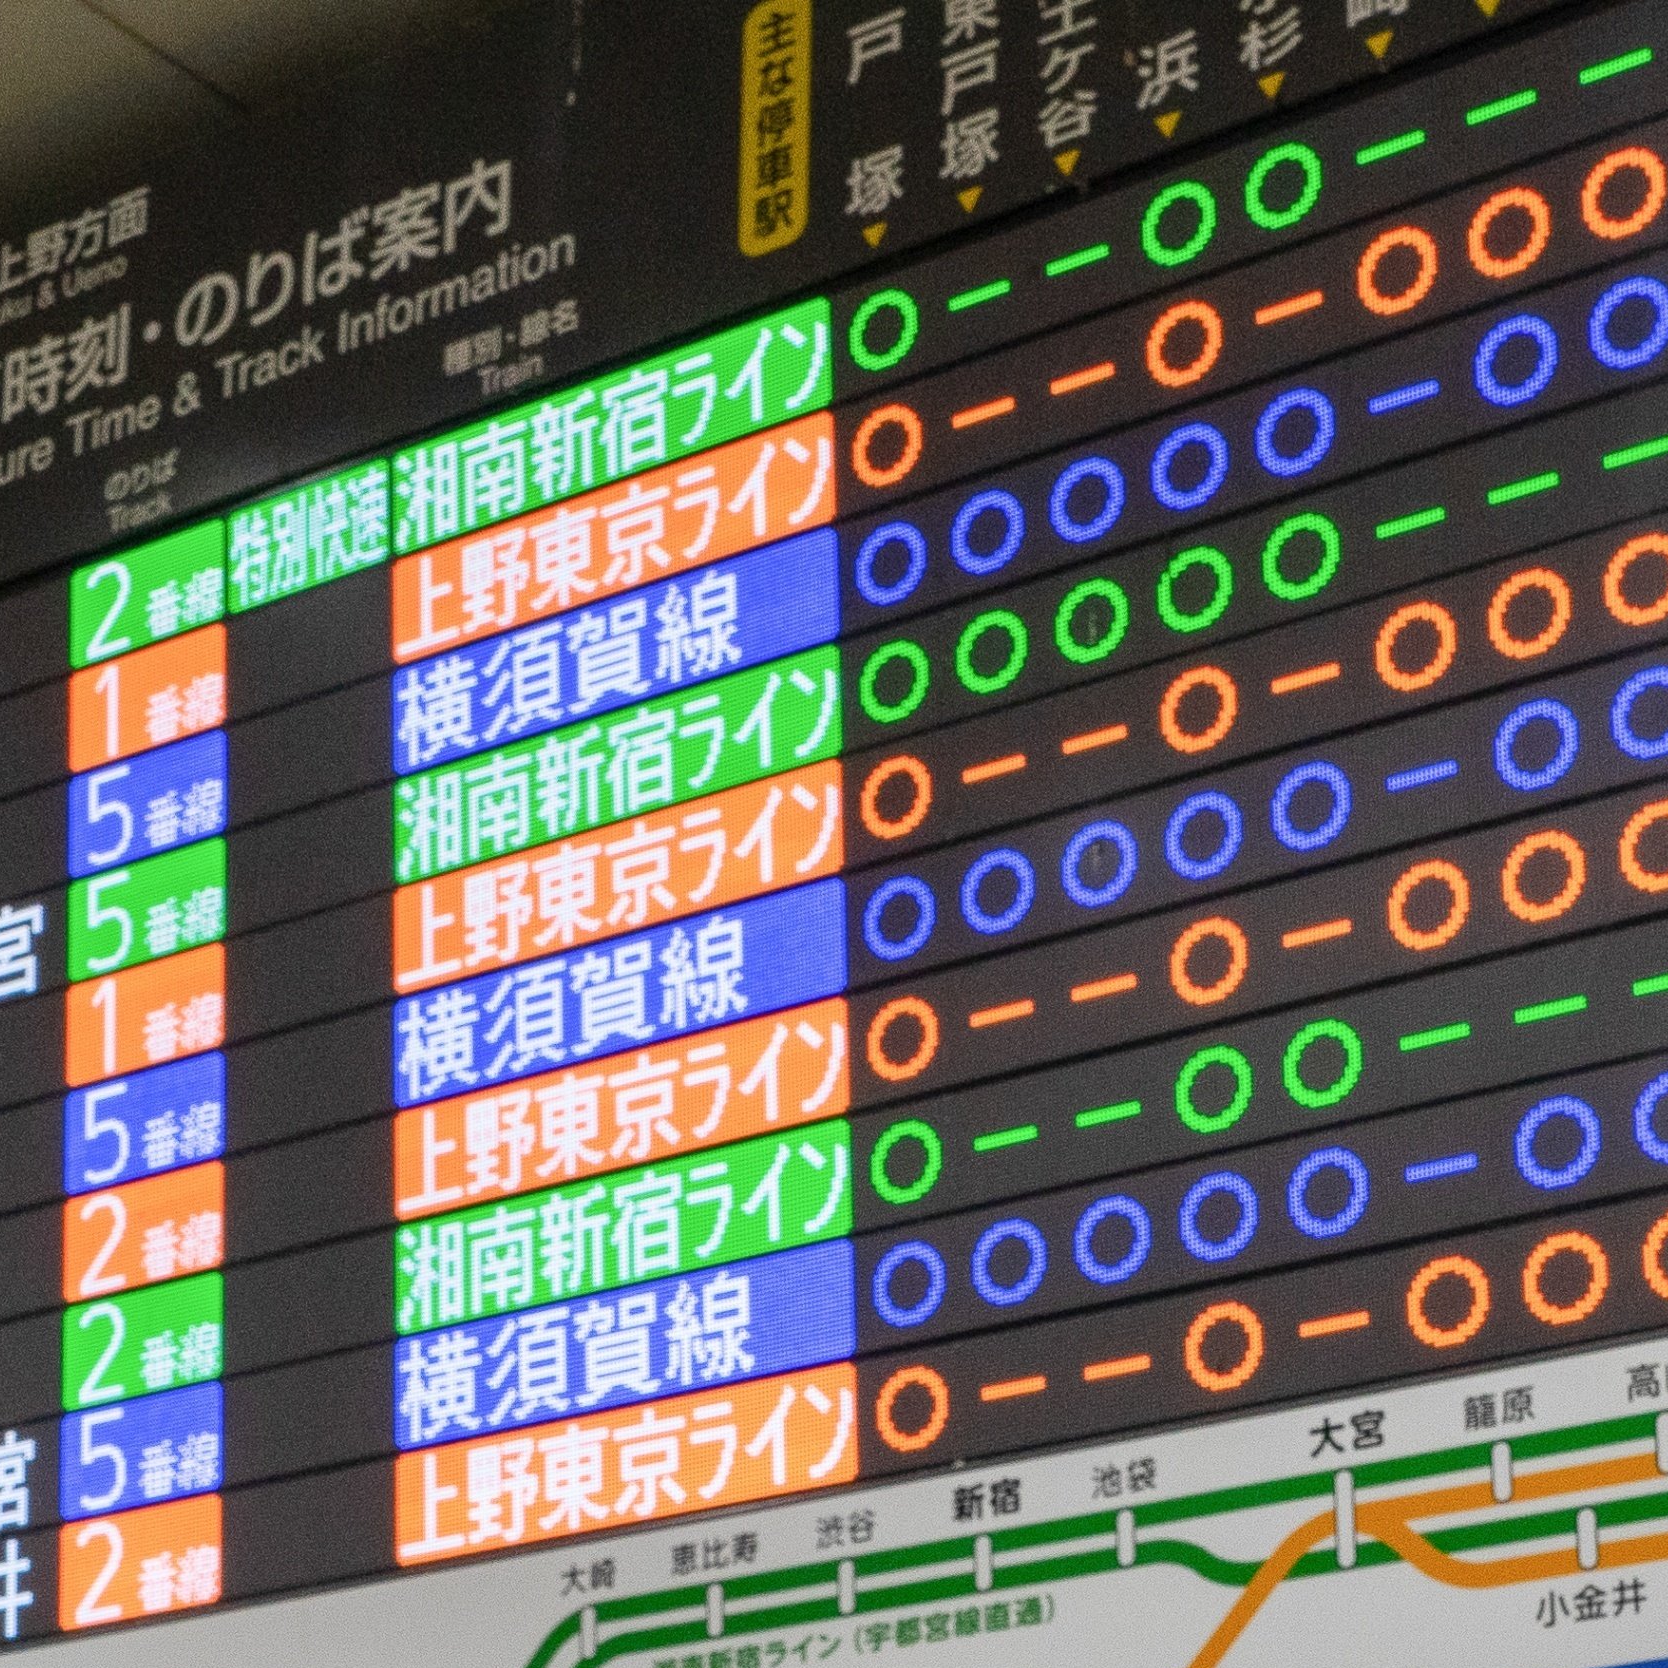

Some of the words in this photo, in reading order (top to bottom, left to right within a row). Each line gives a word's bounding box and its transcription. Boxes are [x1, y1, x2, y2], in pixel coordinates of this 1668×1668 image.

[754, 9, 796, 239] 主な停車駅
[1037, 0, 1098, 148] 土ケ谷
[63, 395, 163, 457] Time
[174, 370, 202, 417] &
[214, 324, 327, 399] Track
[337, 233, 579, 355] Information
[85, 561, 225, 662] 2番線
[231, 466, 390, 610] 特別快速
[395, 320, 829, 551] 湘南新宿ライン
[94, 663, 225, 758] 1番線
[397, 435, 833, 658] 上野東京ライン
[85, 870, 225, 973] 5番線
[397, 668, 839, 883] 湘南新宿ライン
[86, 765, 225, 867] 5番線
[397, 570, 743, 766] 横須賀線
[91, 978, 224, 1077] 1番線
[397, 782, 840, 988] 上野東京ライン
[79, 1193, 223, 1300] 2番線
[397, 1018, 848, 1214] 上野東京ライン
[82, 1081, 223, 1186] 5番線
[397, 914, 748, 1100] 横須賀線
[77, 1301, 222, 1407] 2番線
[398, 1140, 848, 1330] 湘南新宿ライン
[77, 1406, 221, 1512] 5番線
[398, 1269, 755, 1443] 横須賀線
[74, 1520, 221, 1627] 2番線
[398, 1383, 853, 1560] 上野東京ライン
[815, 1508, 876, 1551] 渋谷
[952, 1477, 1022, 1523] 新宿
[1090, 1456, 1158, 1499] 池袋
[1309, 1409, 1387, 1459] 大宮
[560, 1557, 617, 1597] 大崎
[671, 1532, 759, 1577] 恵比寿
[1534, 1578, 1648, 1629] 小金井
